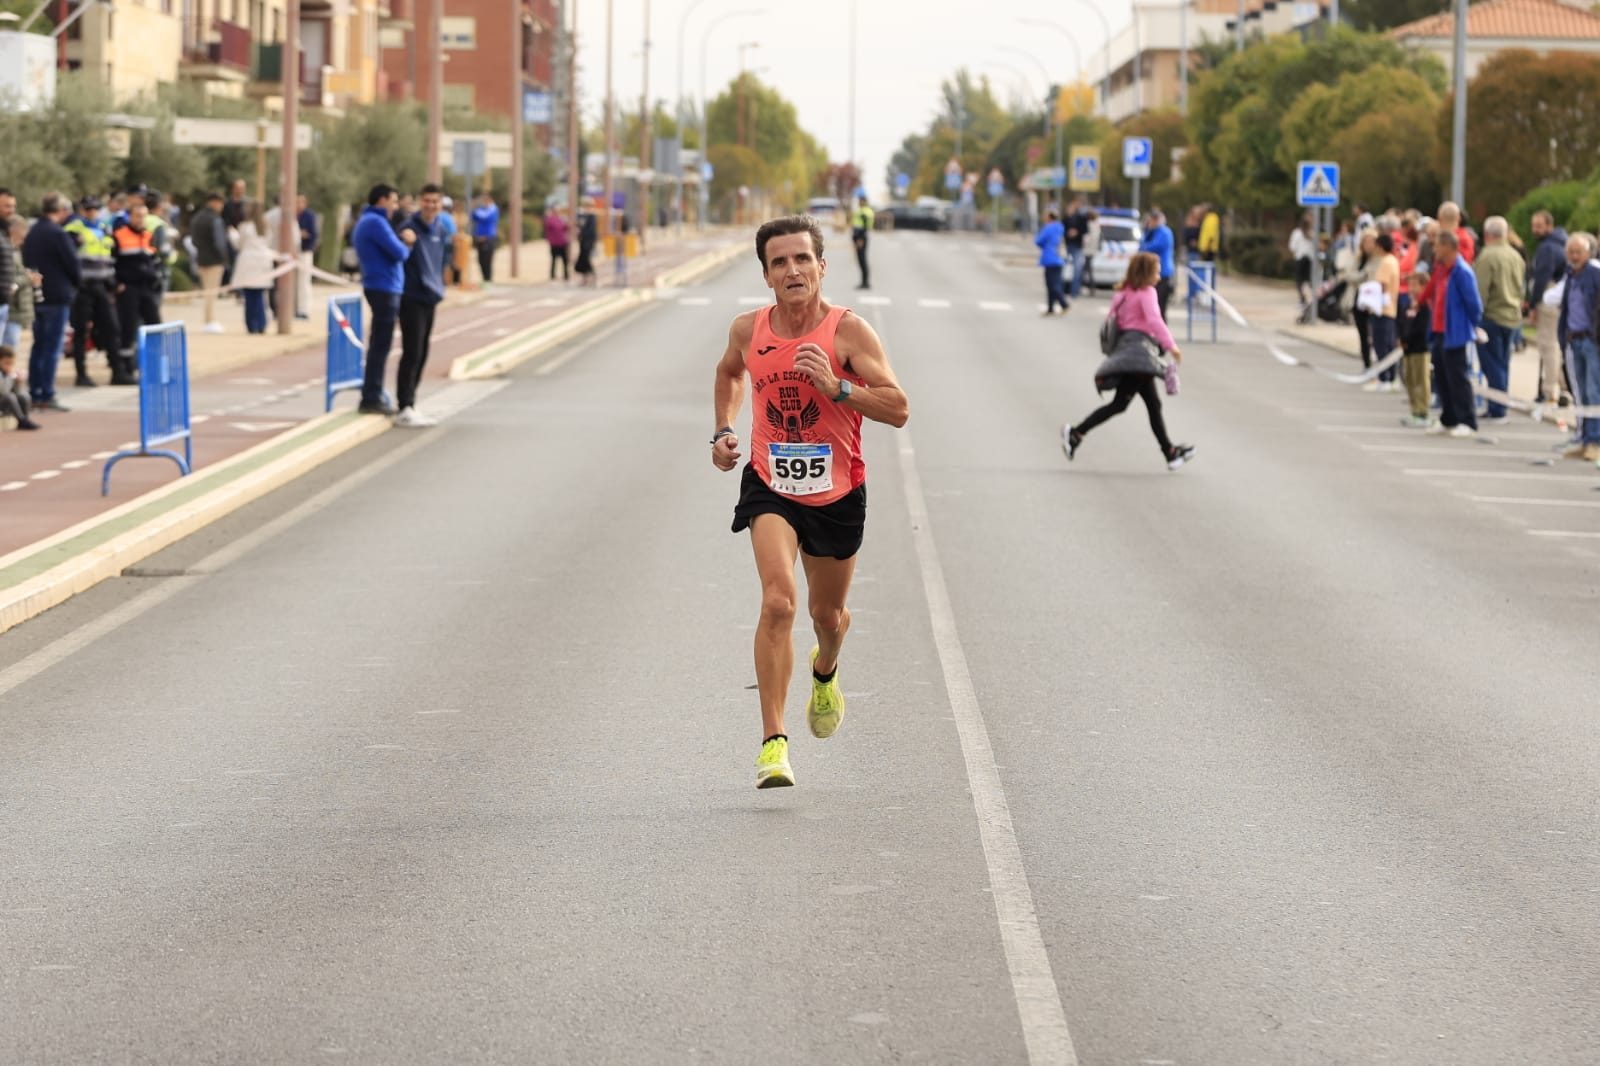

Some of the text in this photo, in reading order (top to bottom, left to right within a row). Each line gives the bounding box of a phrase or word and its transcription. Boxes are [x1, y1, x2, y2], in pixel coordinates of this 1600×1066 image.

[1127, 141, 1145, 162] P
[767, 372, 780, 384] LA
[779, 387, 799, 398] RUN
[780, 400, 802, 411] CLUB
[775, 457, 825, 480] 595
